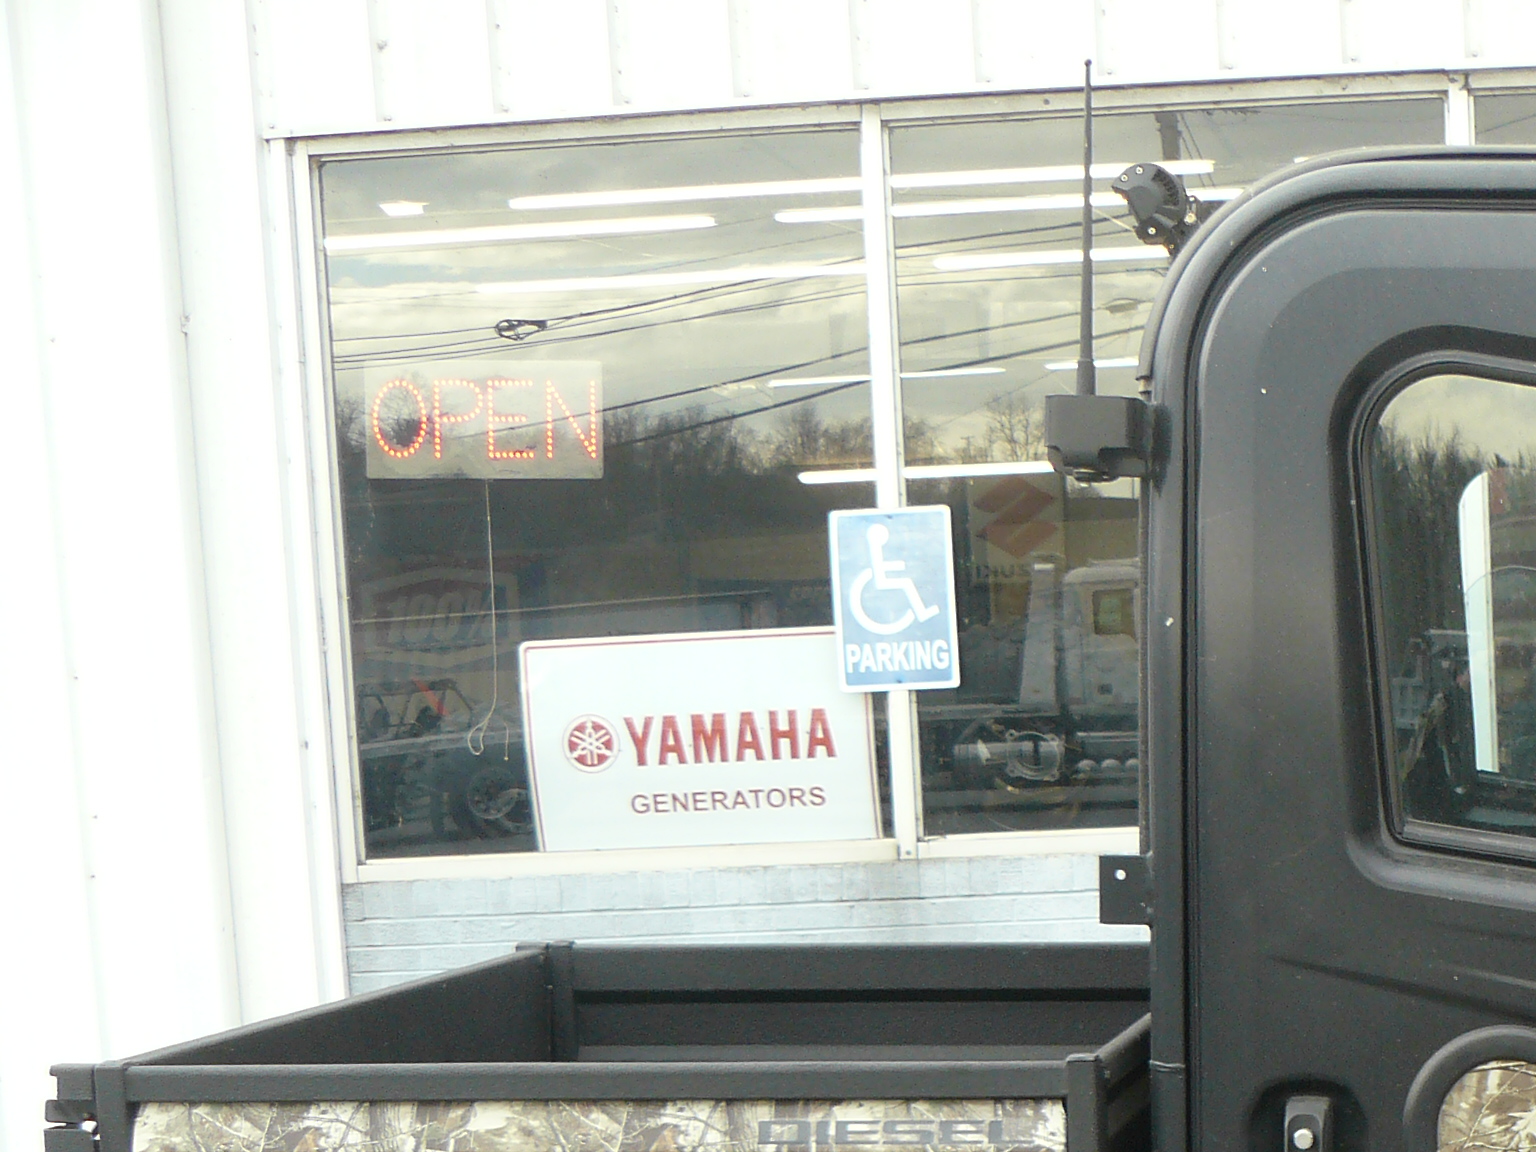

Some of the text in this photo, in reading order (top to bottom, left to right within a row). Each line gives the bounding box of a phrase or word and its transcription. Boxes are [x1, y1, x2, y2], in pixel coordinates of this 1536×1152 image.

[372, 378, 599, 460] OPEN
[845, 638, 950, 674] PARKING
[623, 707, 838, 768] YAMAHA
[631, 786, 827, 815] GENERATORS
[757, 1119, 1036, 1145] DIESEL
